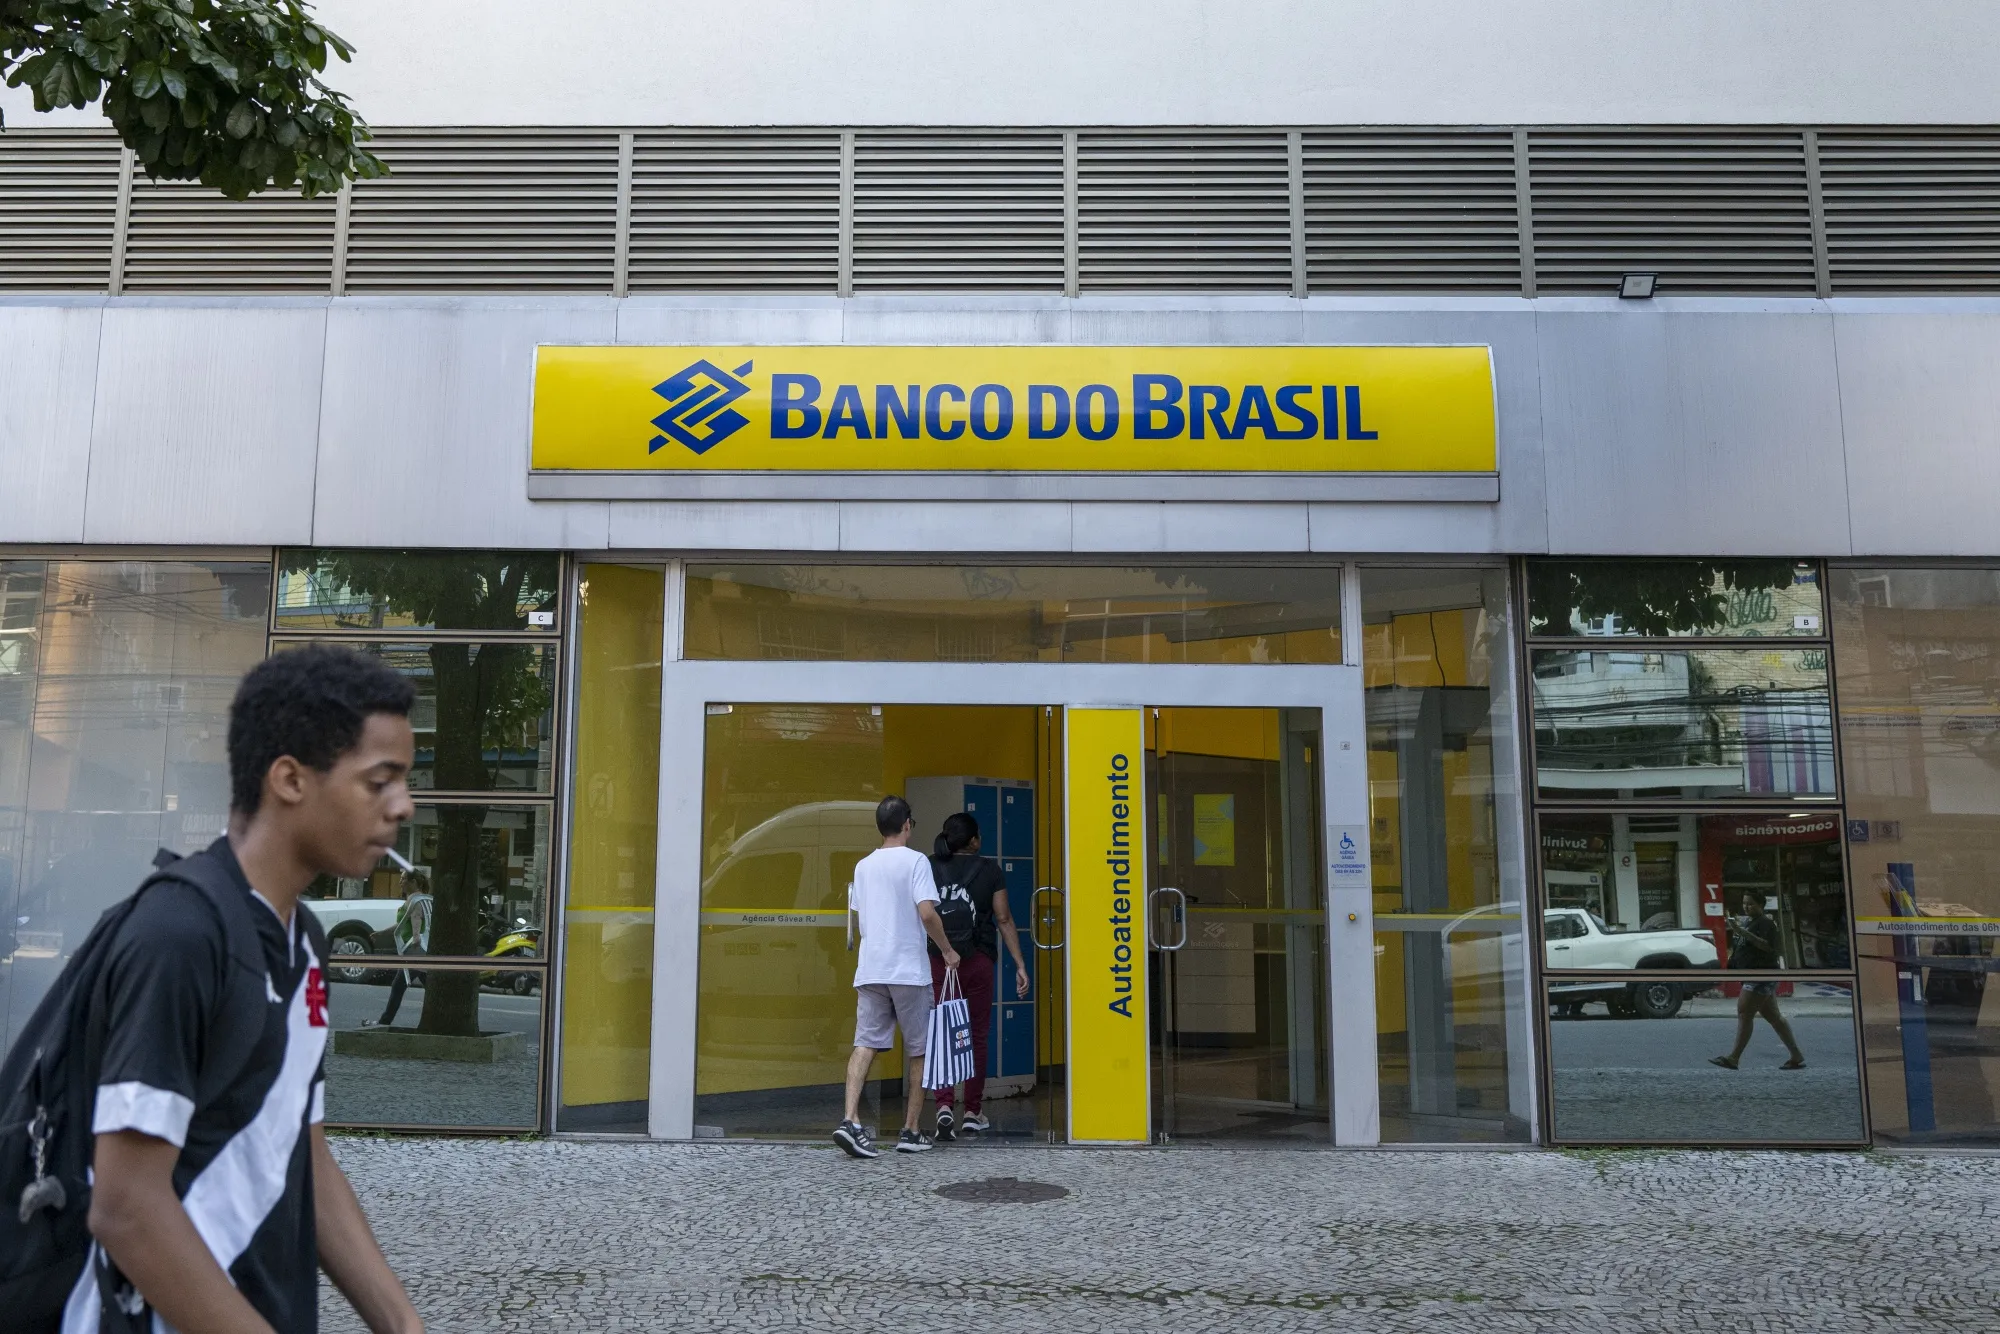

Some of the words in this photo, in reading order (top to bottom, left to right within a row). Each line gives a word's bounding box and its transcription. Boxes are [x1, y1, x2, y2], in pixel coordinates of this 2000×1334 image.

[771, 373, 1014, 440] BANCO
[1029, 384, 1120, 440] DO
[1133, 373, 1379, 441] BRASIL
[1107, 754, 1133, 1018] Autoatendimento
[742, 914, 775, 924] Agência
[777, 914, 803, 923] Gávea
[805, 915, 817, 923] RJ
[1877, 921, 1960, 932] Autoatendimento
[1962, 923, 1979, 932] das
[1981, 922, 2000, 932] 06h
